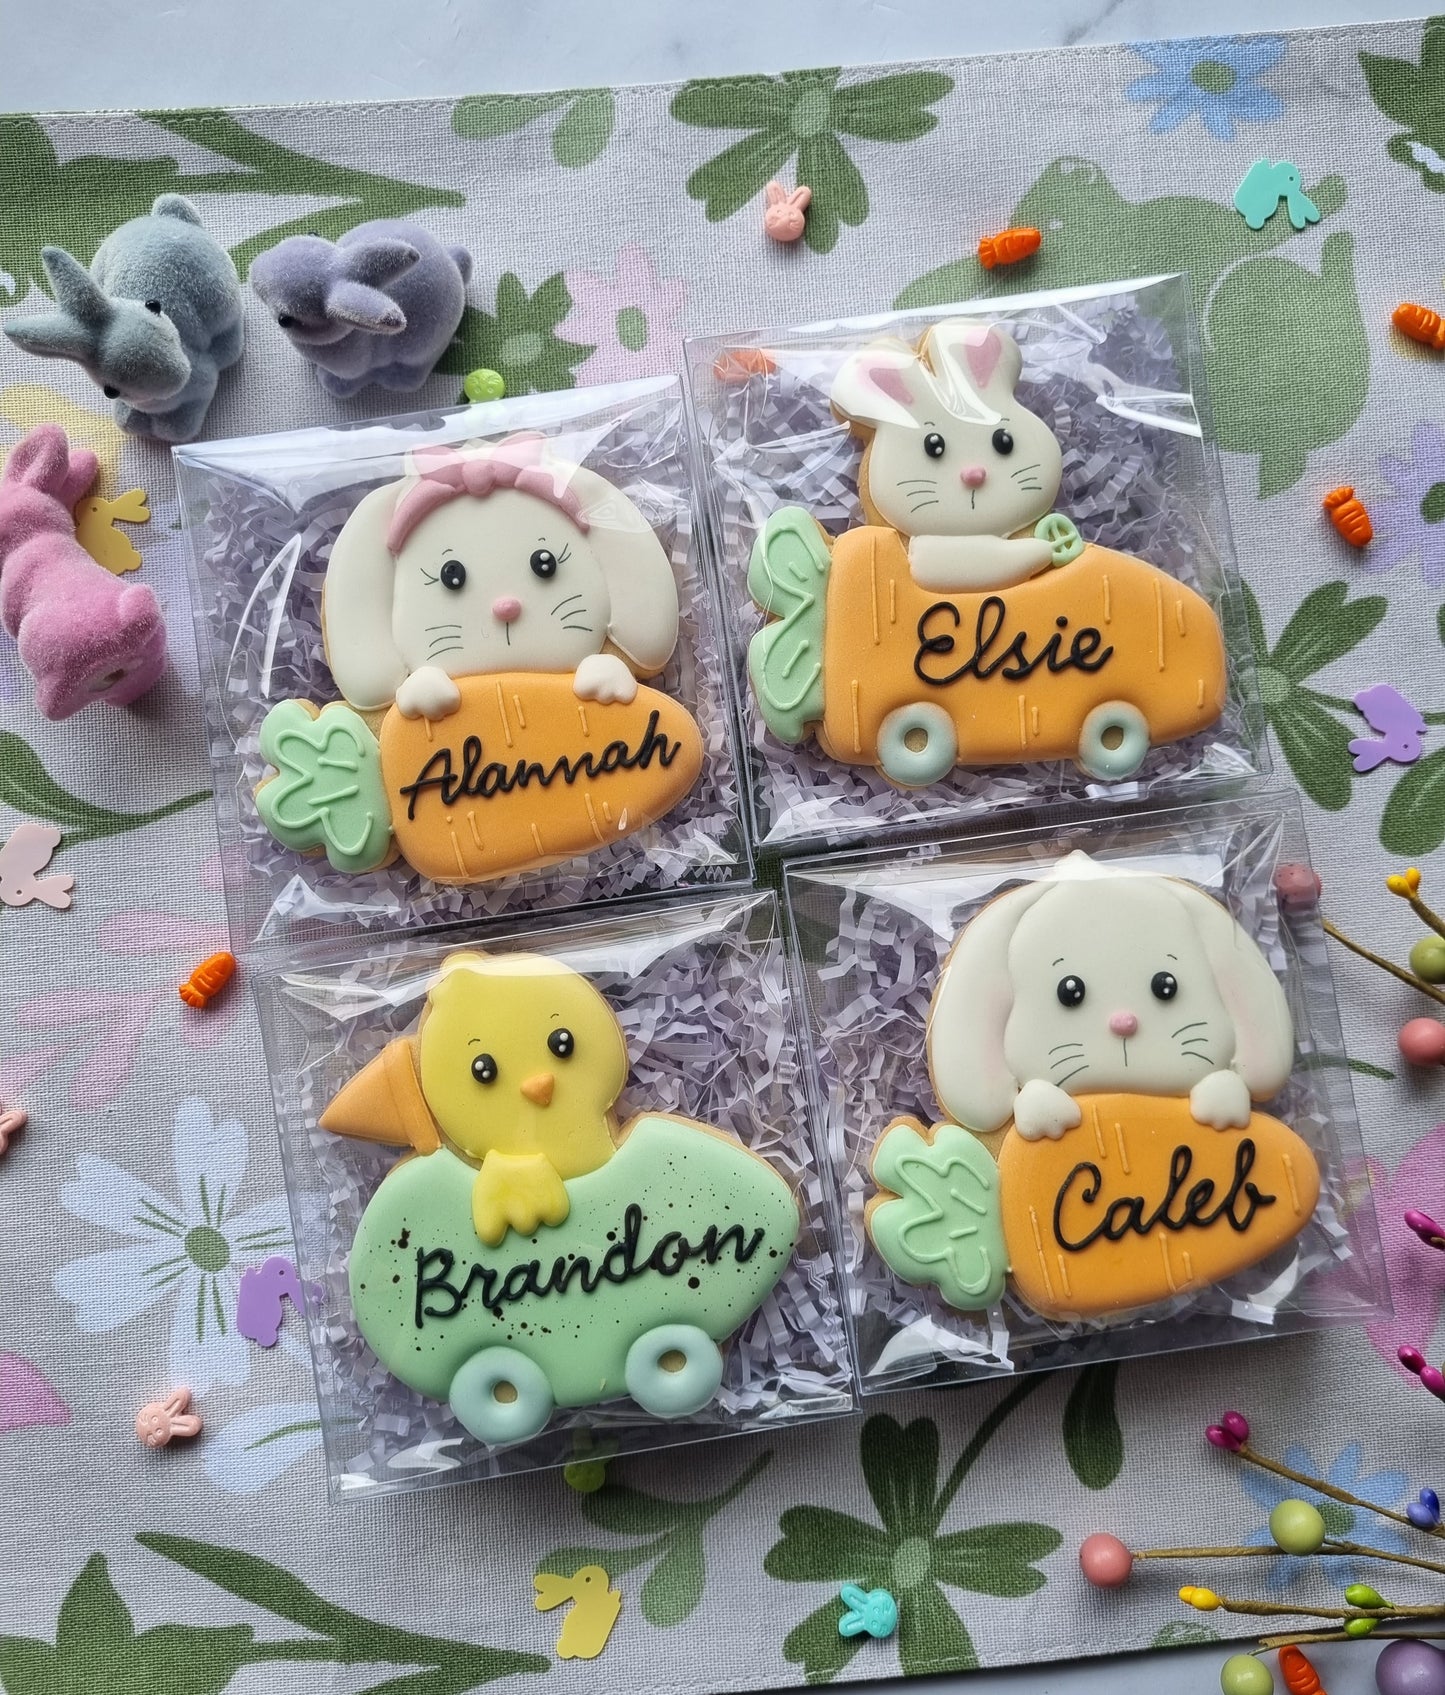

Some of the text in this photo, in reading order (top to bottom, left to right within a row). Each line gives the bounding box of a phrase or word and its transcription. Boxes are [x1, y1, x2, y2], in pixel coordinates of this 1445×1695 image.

[913, 596, 1114, 688] Elsie
[399, 710, 682, 821] Alannah
[1053, 1138, 1277, 1253] Caleb
[415, 1203, 766, 1330] Brandon
